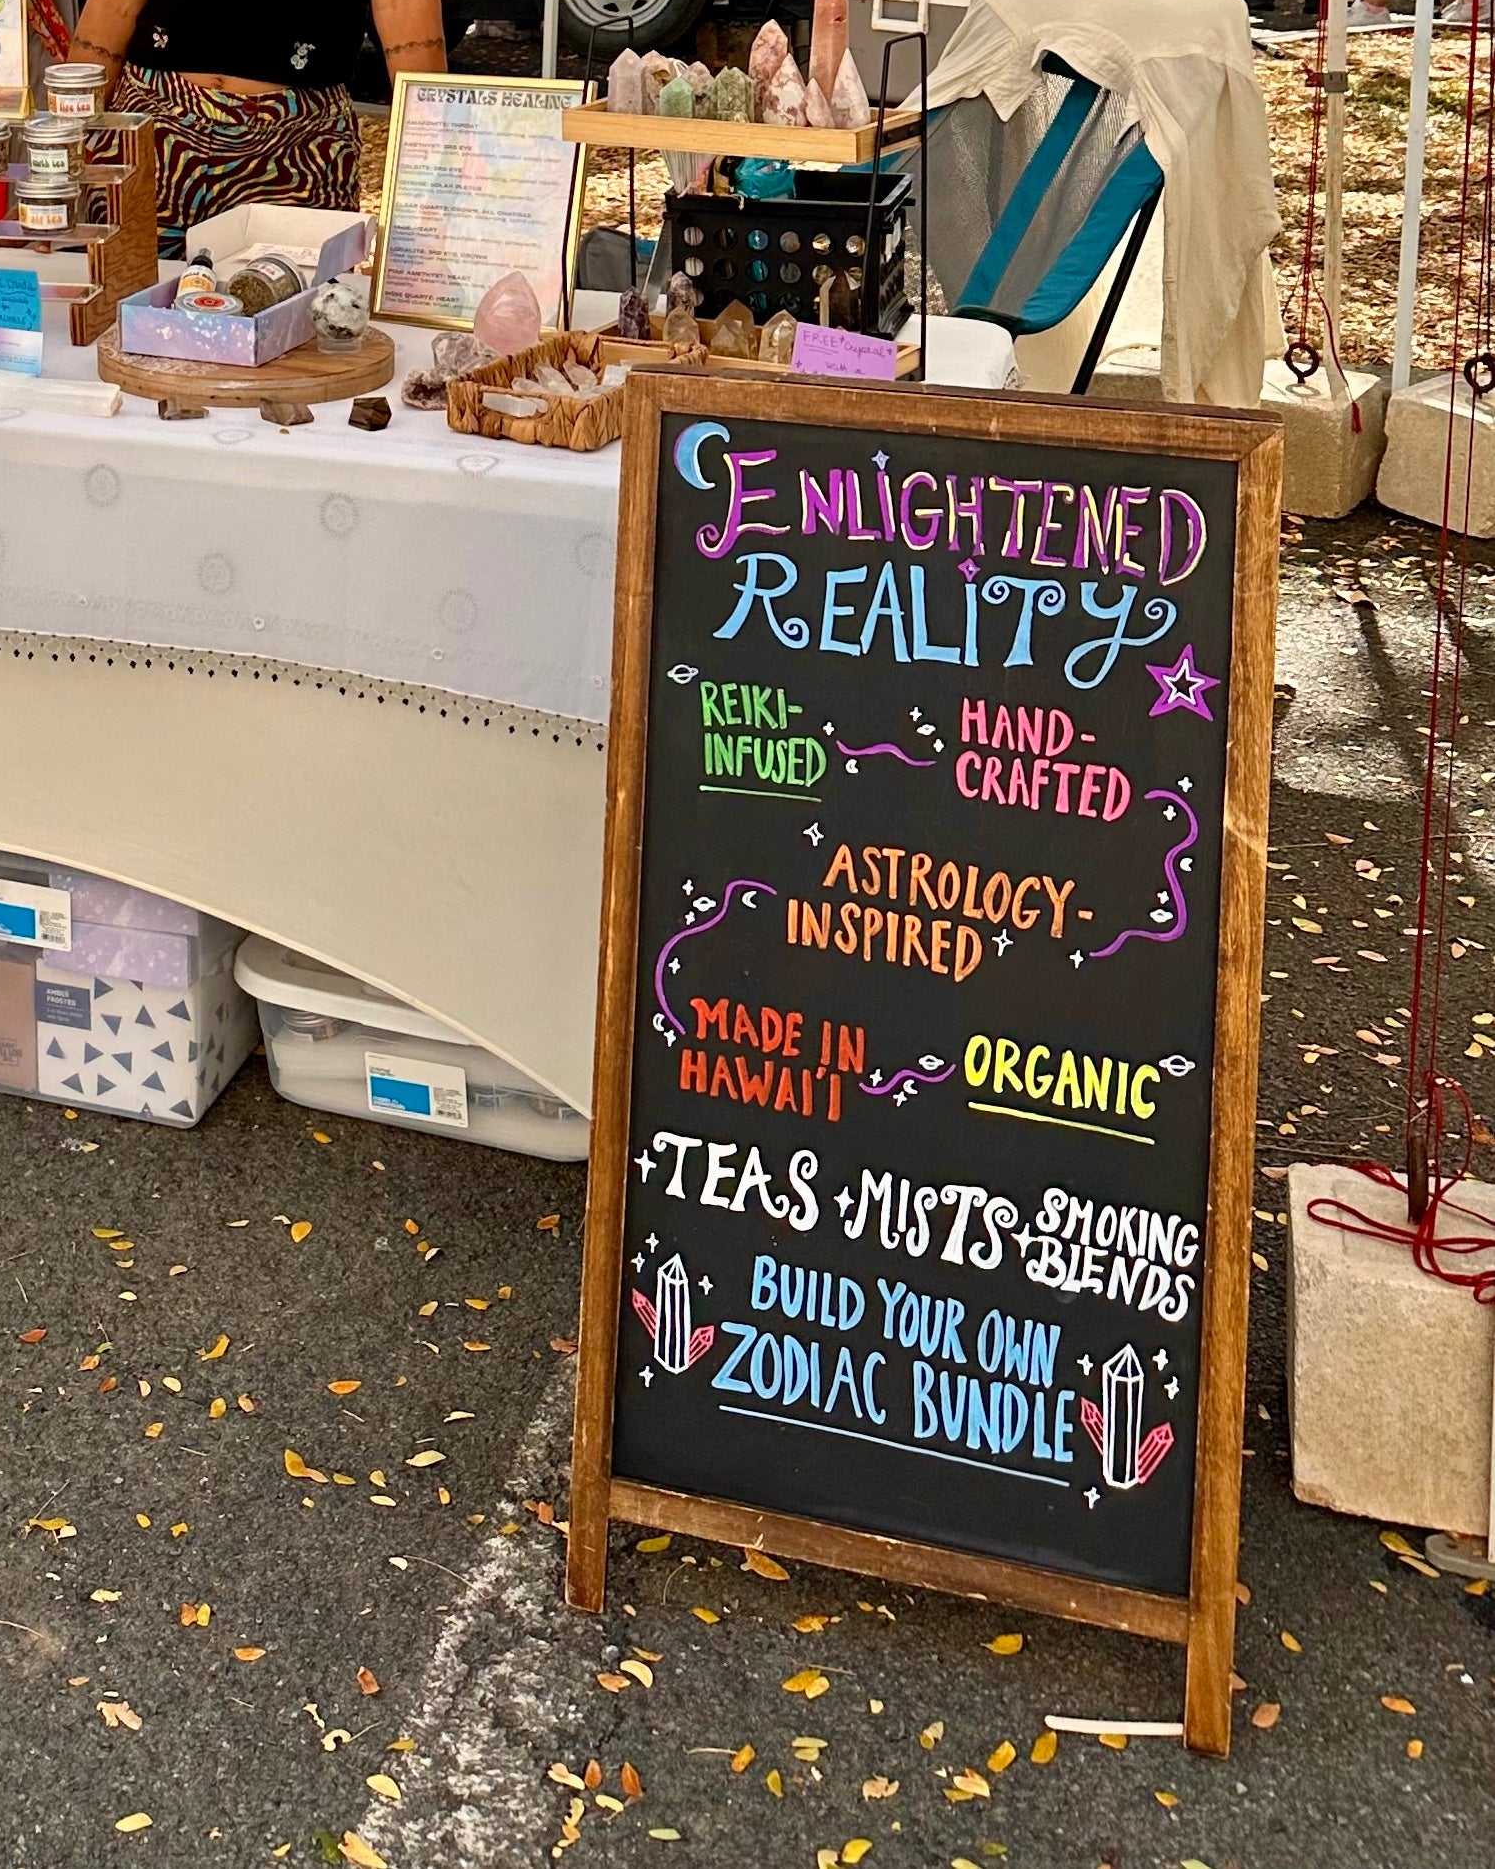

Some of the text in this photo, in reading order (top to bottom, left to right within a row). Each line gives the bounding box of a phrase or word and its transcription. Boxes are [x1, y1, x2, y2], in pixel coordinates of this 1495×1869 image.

[417, 88, 572, 110] CRYSTALS HEALING
[803, 330, 839, 348] FREE
[695, 449, 1207, 586] ENLIGHTENED
[712, 553, 1178, 689] REALITY
[699, 681, 803, 730] REIKI-
[960, 697, 1096, 755] HAND-
[704, 731, 827, 788] INFUSED
[955, 750, 1132, 822] CRAFTED
[822, 843, 1093, 939] ASTROLOGY-
[785, 899, 983, 982] INSPIRED
[689, 997, 865, 1075] MADE IN
[963, 1034, 1162, 1119] ORGANIC
[651, 1131, 1199, 1270] TEAS MISTS SMOKING
[1025, 1234, 1195, 1323] BLENDS
[750, 1254, 1061, 1389] BUILD YOUR OWN
[711, 1321, 1074, 1462] ZODIAC BUNDLE
